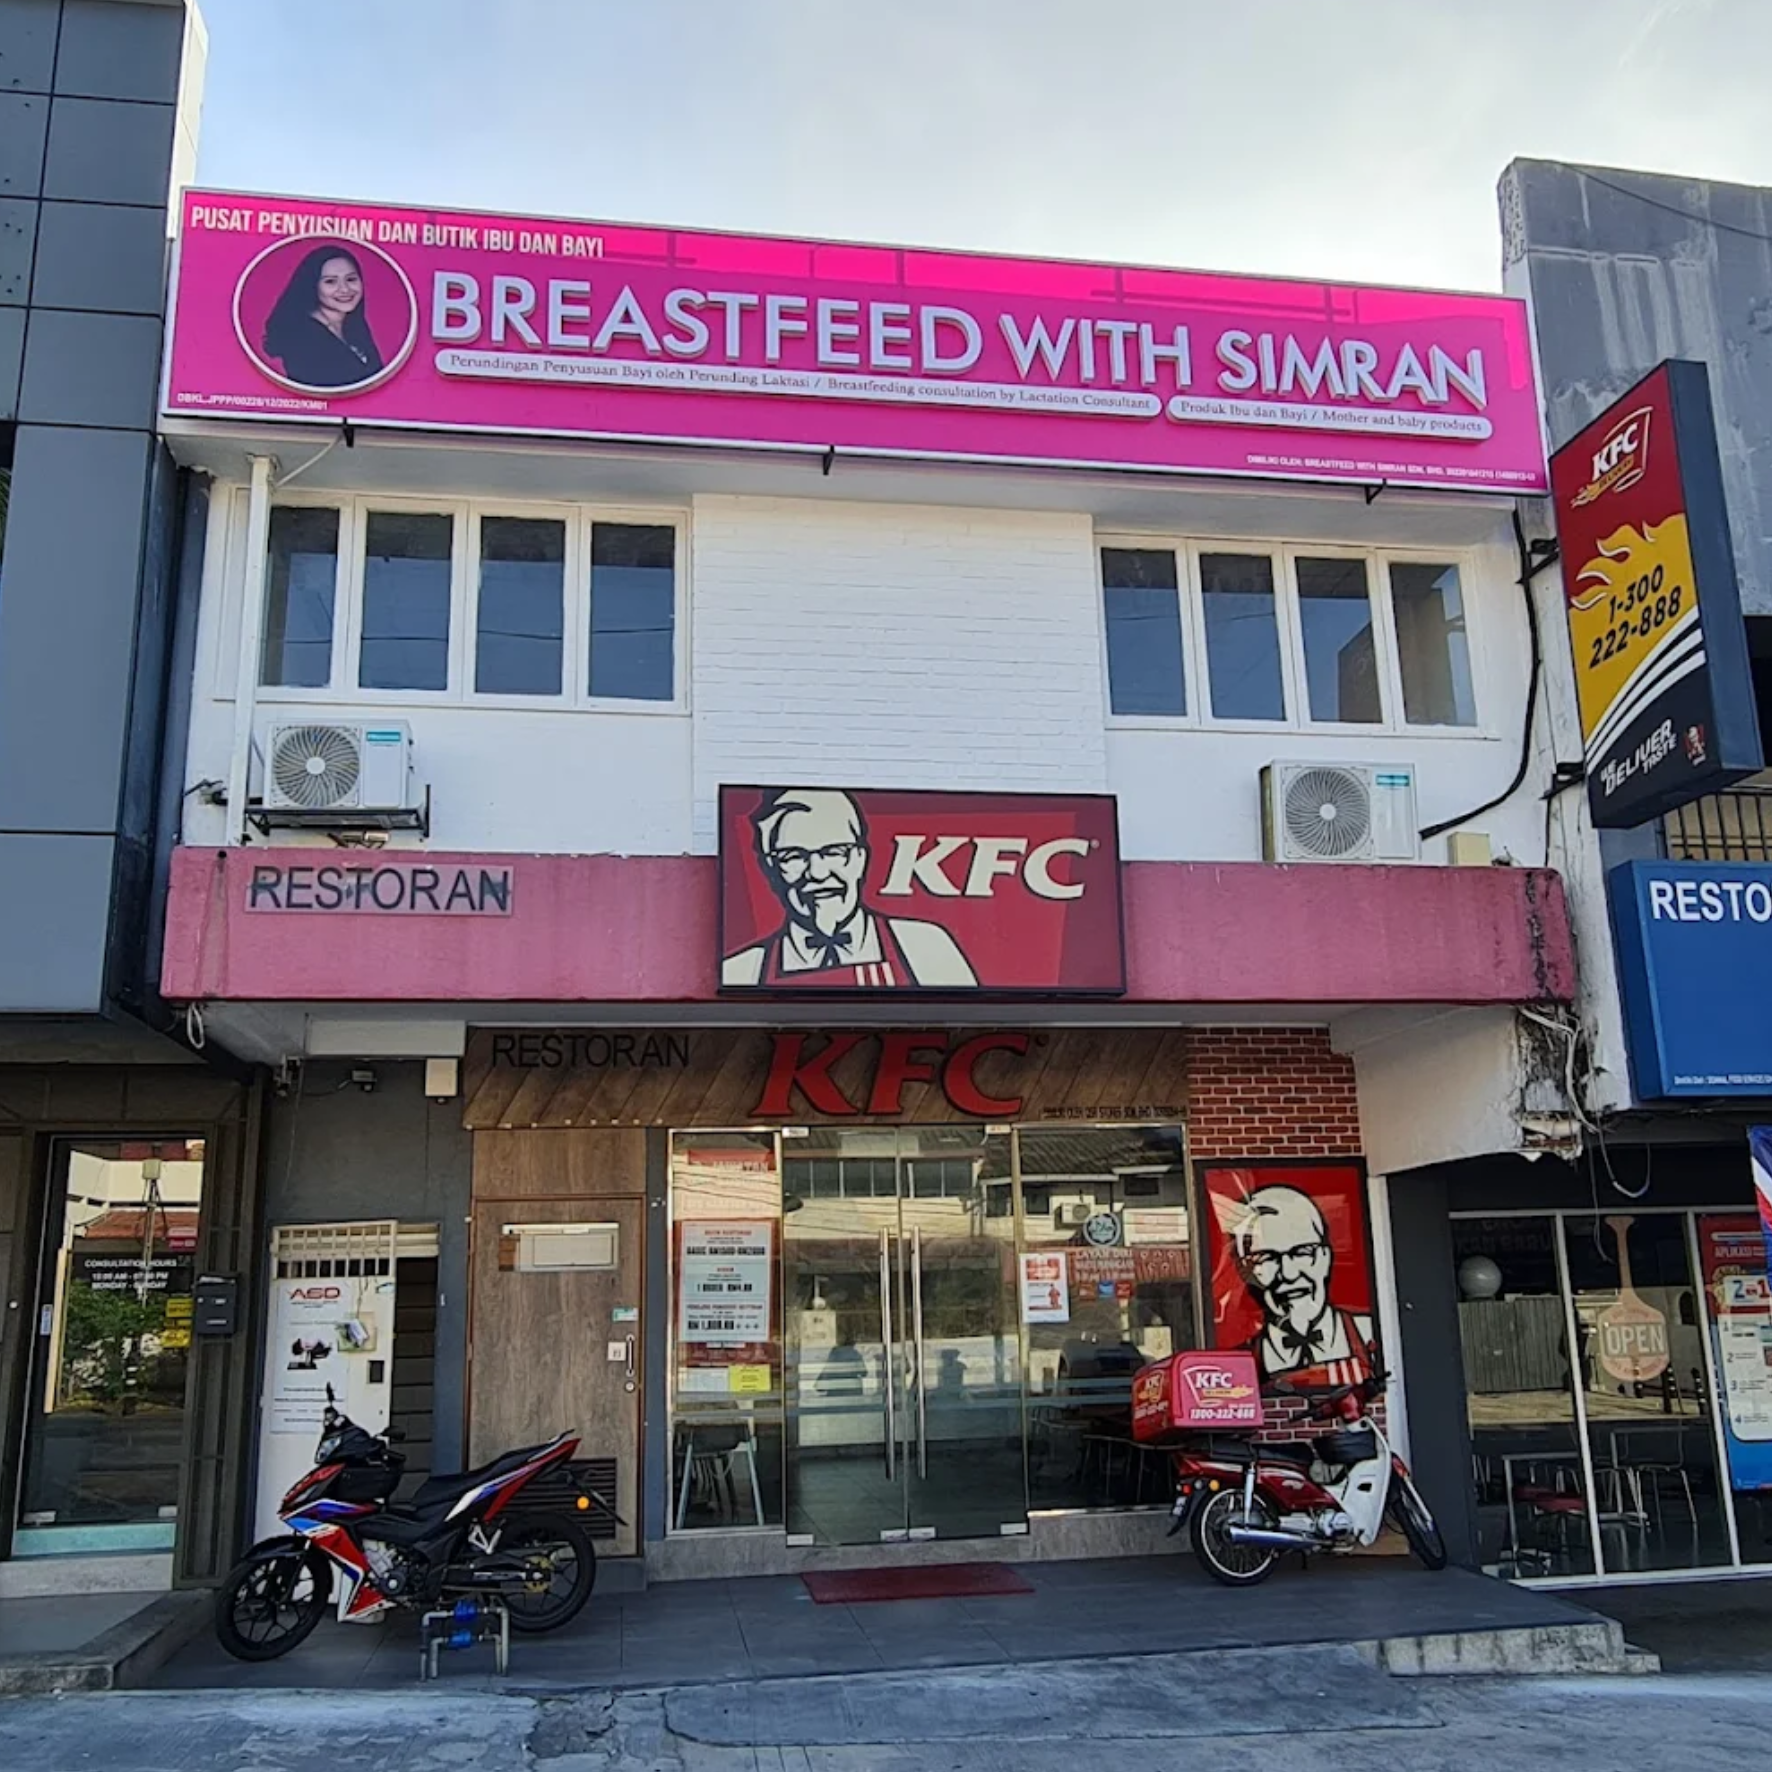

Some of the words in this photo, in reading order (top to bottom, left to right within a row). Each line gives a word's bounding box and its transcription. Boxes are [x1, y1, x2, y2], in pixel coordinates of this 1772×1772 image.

[190, 206, 253, 231] PUSAT
[258, 210, 373, 241] PENYUSUAN
[378, 220, 417, 244] DAN
[422, 224, 478, 249] BUTIK
[483, 229, 514, 251] IBU
[519, 232, 556, 255] DAN
[561, 235, 604, 259] BAYI
[431, 271, 982, 374] BREASTFEED
[998, 313, 1191, 388] WITH
[1215, 330, 1488, 411] SIMRAN
[450, 354, 539, 372] Perundingan
[543, 360, 618, 376] Penyusuan
[622, 365, 652, 378] Bayi
[656, 367, 685, 380] oleh
[690, 369, 758, 386] Perunding
[762, 374, 810, 388] Laktasi
[828, 378, 915, 396] Breastfeeding
[918, 385, 996, 400] consultation
[1000, 388, 1016, 403] by
[1020, 391, 1079, 405] Lactation
[1083, 394, 1150, 409] Consultant
[1181, 401, 1226, 415] Produk
[1230, 405, 1250, 416] Ibu
[1253, 407, 1277, 418] dan
[1280, 409, 1308, 422] Bayi
[1323, 410, 1369, 424] Mother
[1373, 414, 1396, 425] and
[1399, 416, 1427, 430] baby
[1430, 419, 1482, 432] products
[1591, 422, 1639, 482] KFC
[1608, 564, 1664, 624] 1-300
[1588, 585, 1682, 670] 222-888
[1604, 719, 1672, 796] DELIVER
[1642, 733, 1677, 774] TASTE
[250, 866, 509, 911] RESTORAN
[880, 834, 1086, 899] KFC
[492, 1033, 690, 1068] RESTORAN
[750, 1032, 1030, 1119] KFC
[84, 1259, 146, 1268] CONSULTATION
[1733, 1279, 1745, 1298] 2
[1606, 1325, 1665, 1354] OPEN
[1196, 1372, 1232, 1388] KFC
